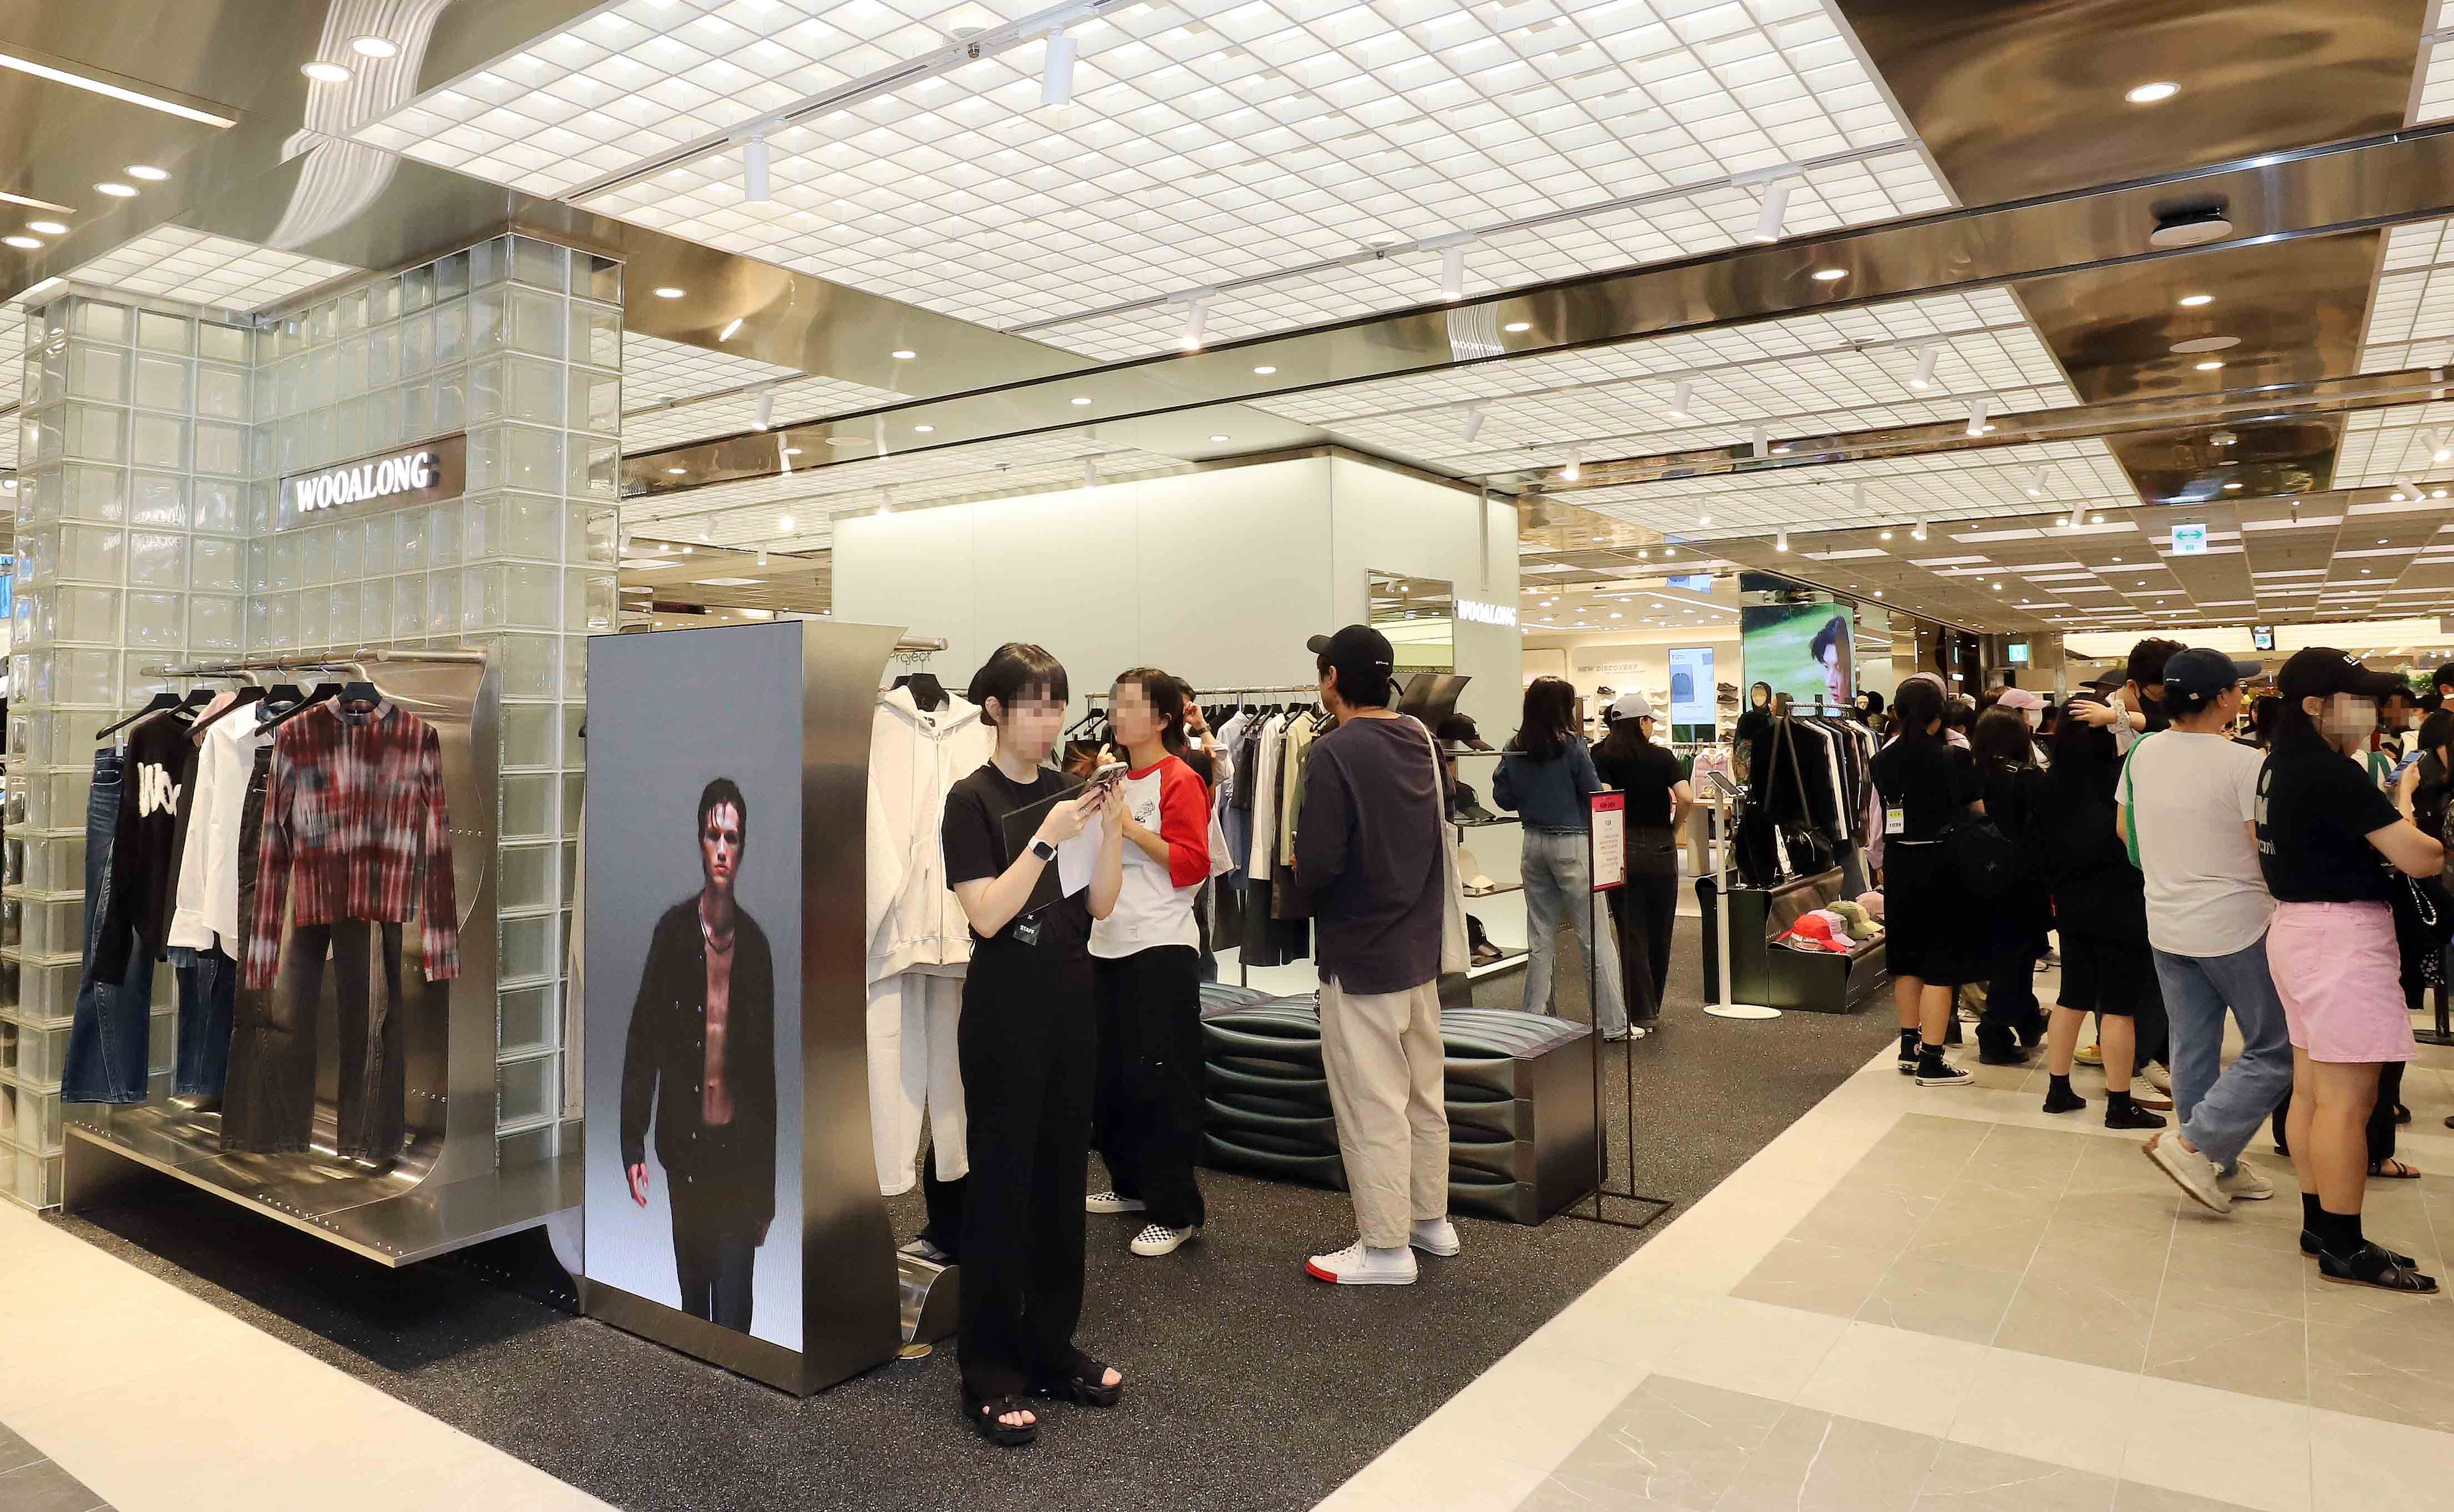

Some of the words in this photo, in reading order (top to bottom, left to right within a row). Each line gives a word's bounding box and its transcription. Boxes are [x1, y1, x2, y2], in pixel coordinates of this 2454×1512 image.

[296, 451, 429, 513] WOOALONG
[1458, 599, 1517, 627] WOOALONG
[1596, 664, 1638, 672] DISCOVERY
[1020, 925, 1035, 934] STAFF
